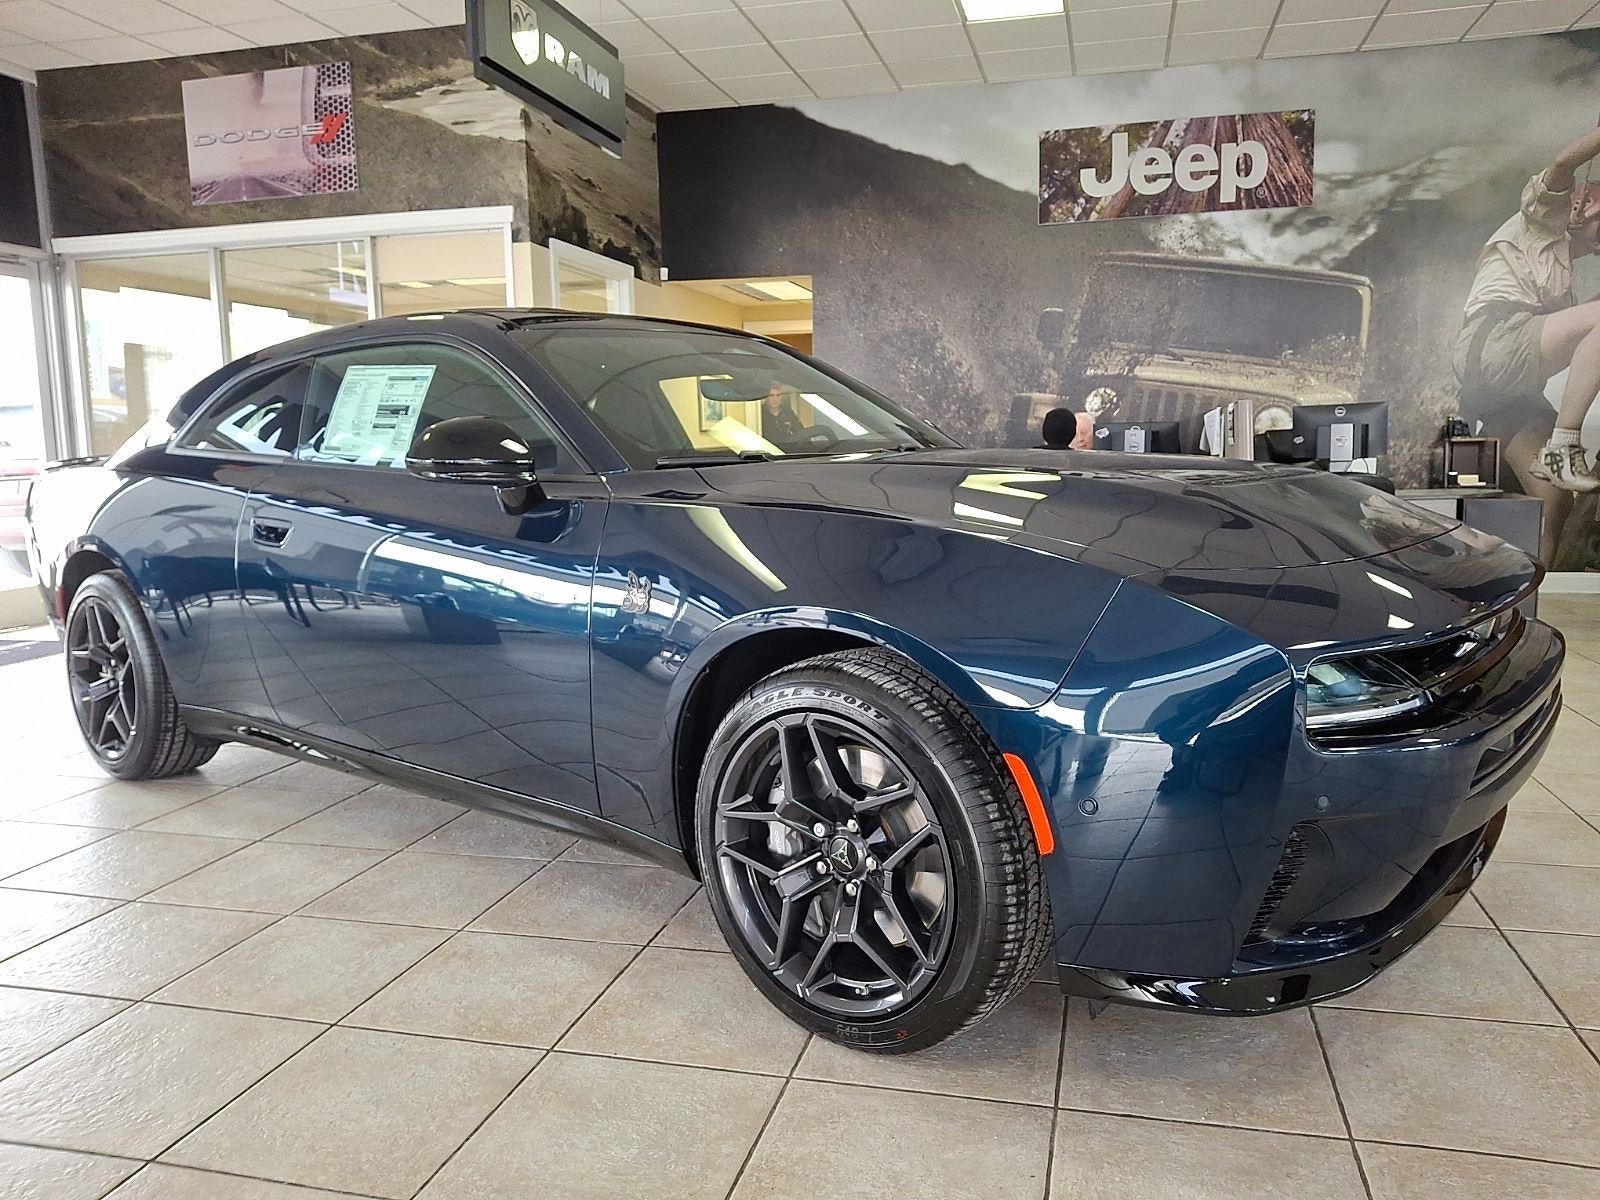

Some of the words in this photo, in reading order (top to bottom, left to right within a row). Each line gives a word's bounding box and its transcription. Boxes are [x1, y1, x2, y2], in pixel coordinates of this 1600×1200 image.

[544, 32, 610, 100] RAM
[193, 122, 325, 147] DODGE
[1079, 132, 1269, 204] Jeep
[744, 688, 805, 717] AGLE
[813, 688, 889, 720] SPORT
